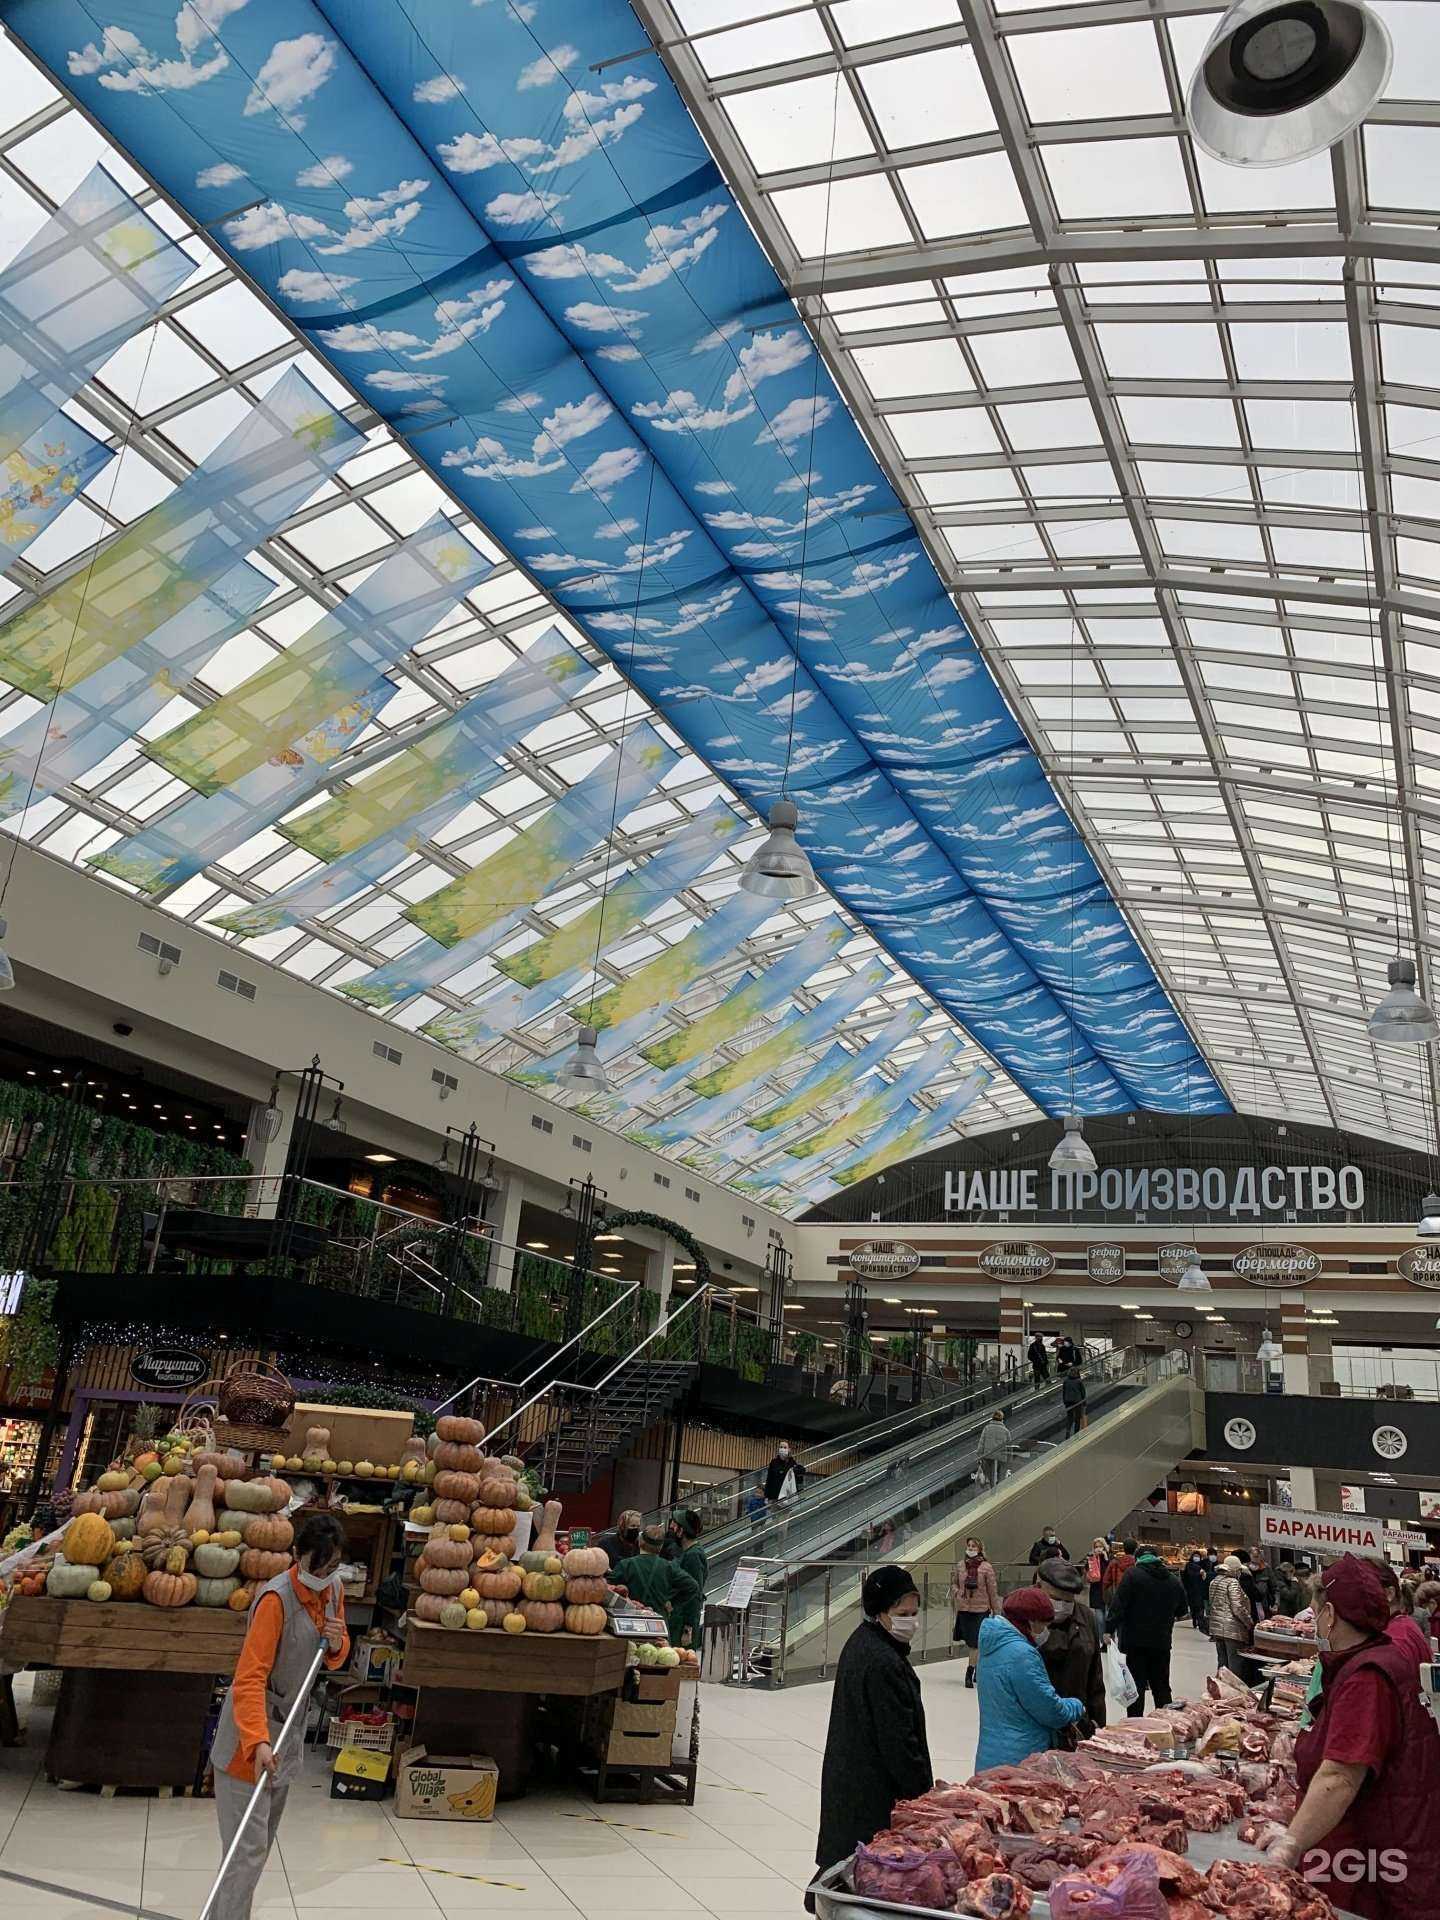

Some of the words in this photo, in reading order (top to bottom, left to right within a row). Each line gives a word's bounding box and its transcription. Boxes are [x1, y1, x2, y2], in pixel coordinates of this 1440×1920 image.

[944, 1169, 1038, 1210] НАШЕ
[1051, 1165, 1365, 1216] ПРОИЗВОДСТВО
[872, 1242, 895, 1254] НАШЕ
[1004, 1243, 1028, 1255] НАШЕ
[1090, 1248, 1121, 1258] зефир
[1256, 1247, 1297, 1259] ПЛОЩАДЬ
[981, 1255, 1050, 1267] молочное
[1236, 1255, 1317, 1273] фермеров
[1091, 1267, 1122, 1276] халва
[1265, 1516, 1377, 1548] БАРАНИНА
[409, 1770, 442, 1783] Global
[411, 1781, 446, 1798] Village
